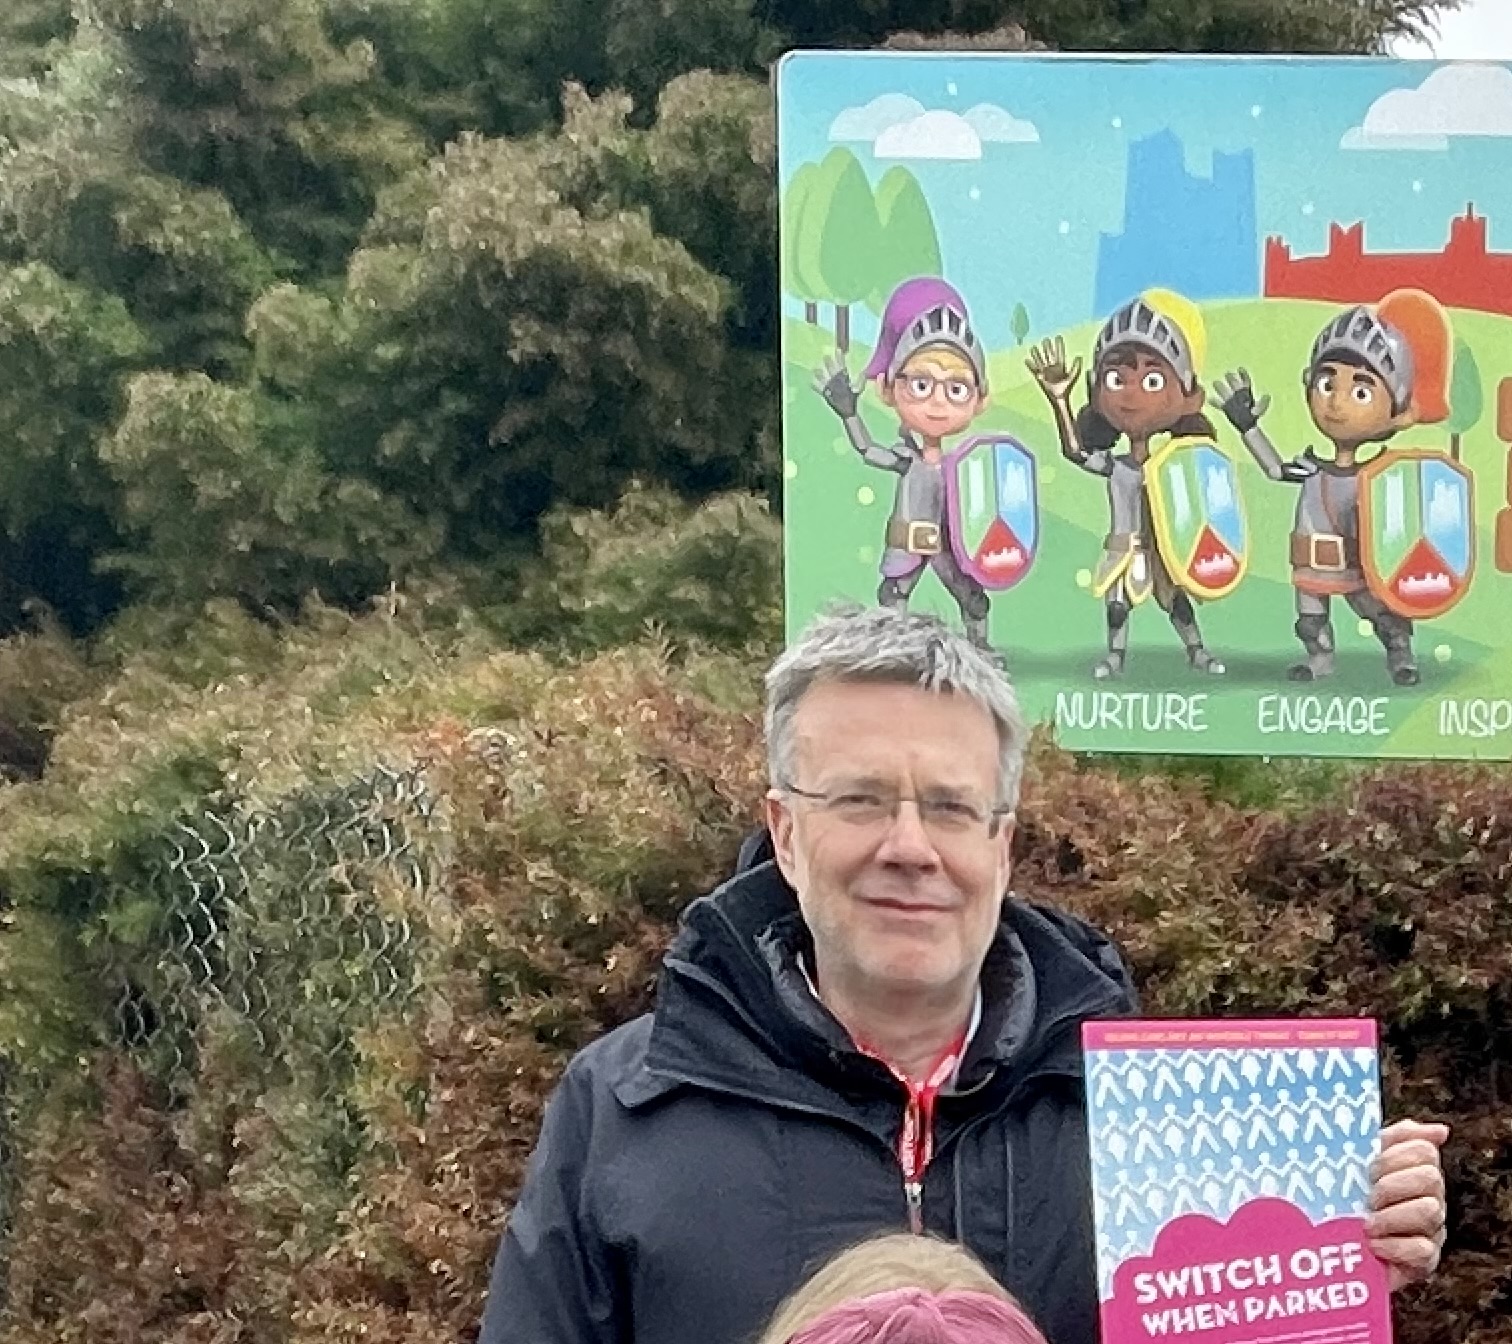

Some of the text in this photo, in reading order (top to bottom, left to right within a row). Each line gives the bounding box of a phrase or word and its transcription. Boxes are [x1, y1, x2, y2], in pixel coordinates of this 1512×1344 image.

[1056, 693, 1208, 730] NURTURE
[1257, 696, 1389, 735] ENGAGE
[1134, 1242, 1364, 1304] SWITCH OFF
[1142, 1280, 1369, 1337] WHEN PARKED
